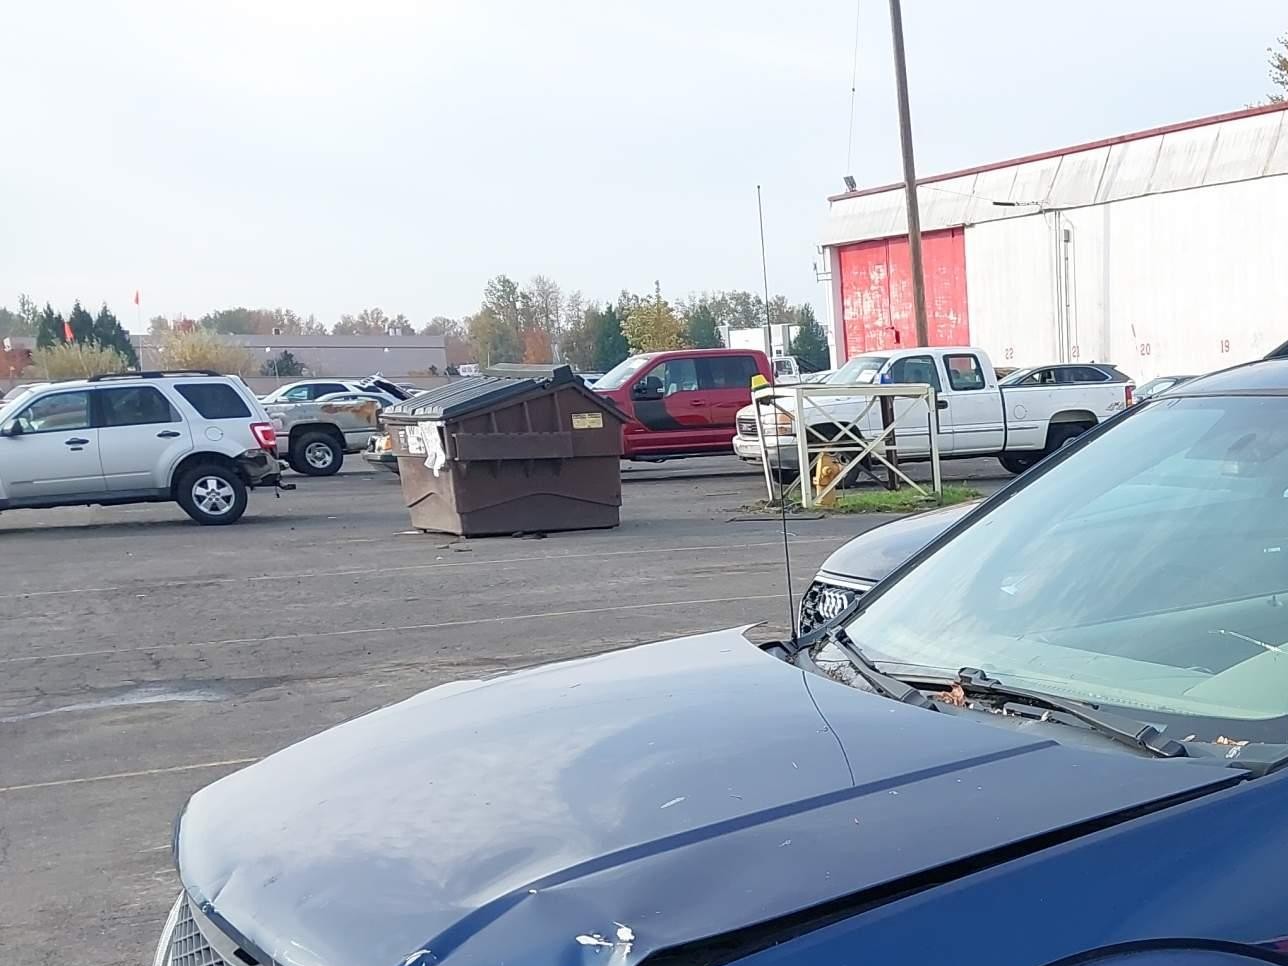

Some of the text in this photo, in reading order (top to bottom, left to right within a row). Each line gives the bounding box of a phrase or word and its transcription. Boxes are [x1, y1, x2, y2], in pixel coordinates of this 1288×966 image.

[1071, 345, 1080, 358] 21
[1139, 343, 1151, 356] 20
[1220, 340, 1230, 353] 19
[1005, 347, 1014, 360] 22
